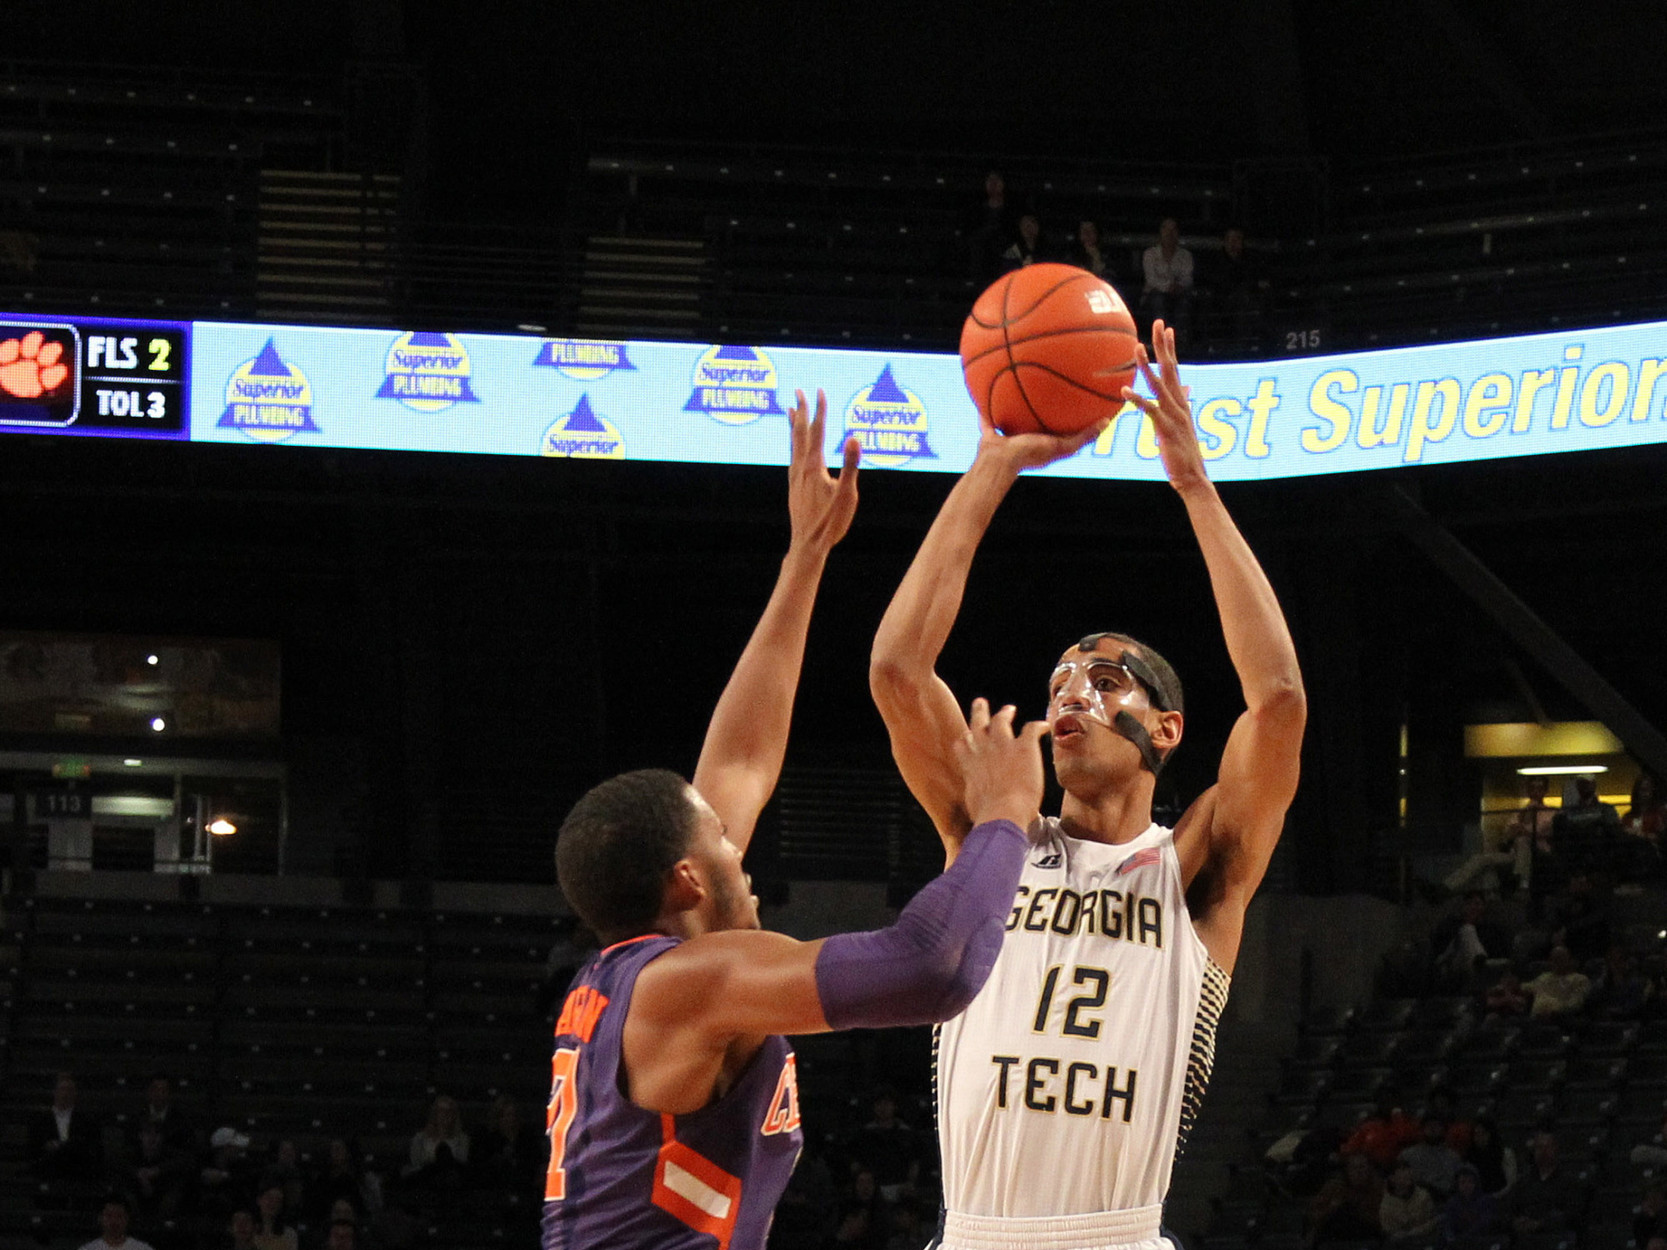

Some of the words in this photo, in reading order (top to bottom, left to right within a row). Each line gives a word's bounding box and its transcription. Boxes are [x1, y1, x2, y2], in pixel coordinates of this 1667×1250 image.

[87, 335, 138, 370] FLS
[148, 338, 172, 371] 2
[1286, 328, 1321, 350] 215
[394, 350, 465, 374] Superior
[700, 363, 771, 387] Superior
[95, 389, 145, 418] TOL
[147, 391, 166, 419] 3
[232, 378, 306, 403] Superior
[1301, 343, 1667, 464] Superior
[851, 405, 922, 429] Superior
[1005, 886, 1164, 951] GEORGIA
[1032, 964, 1113, 1041] 12
[991, 1055, 1139, 1124] TECH
